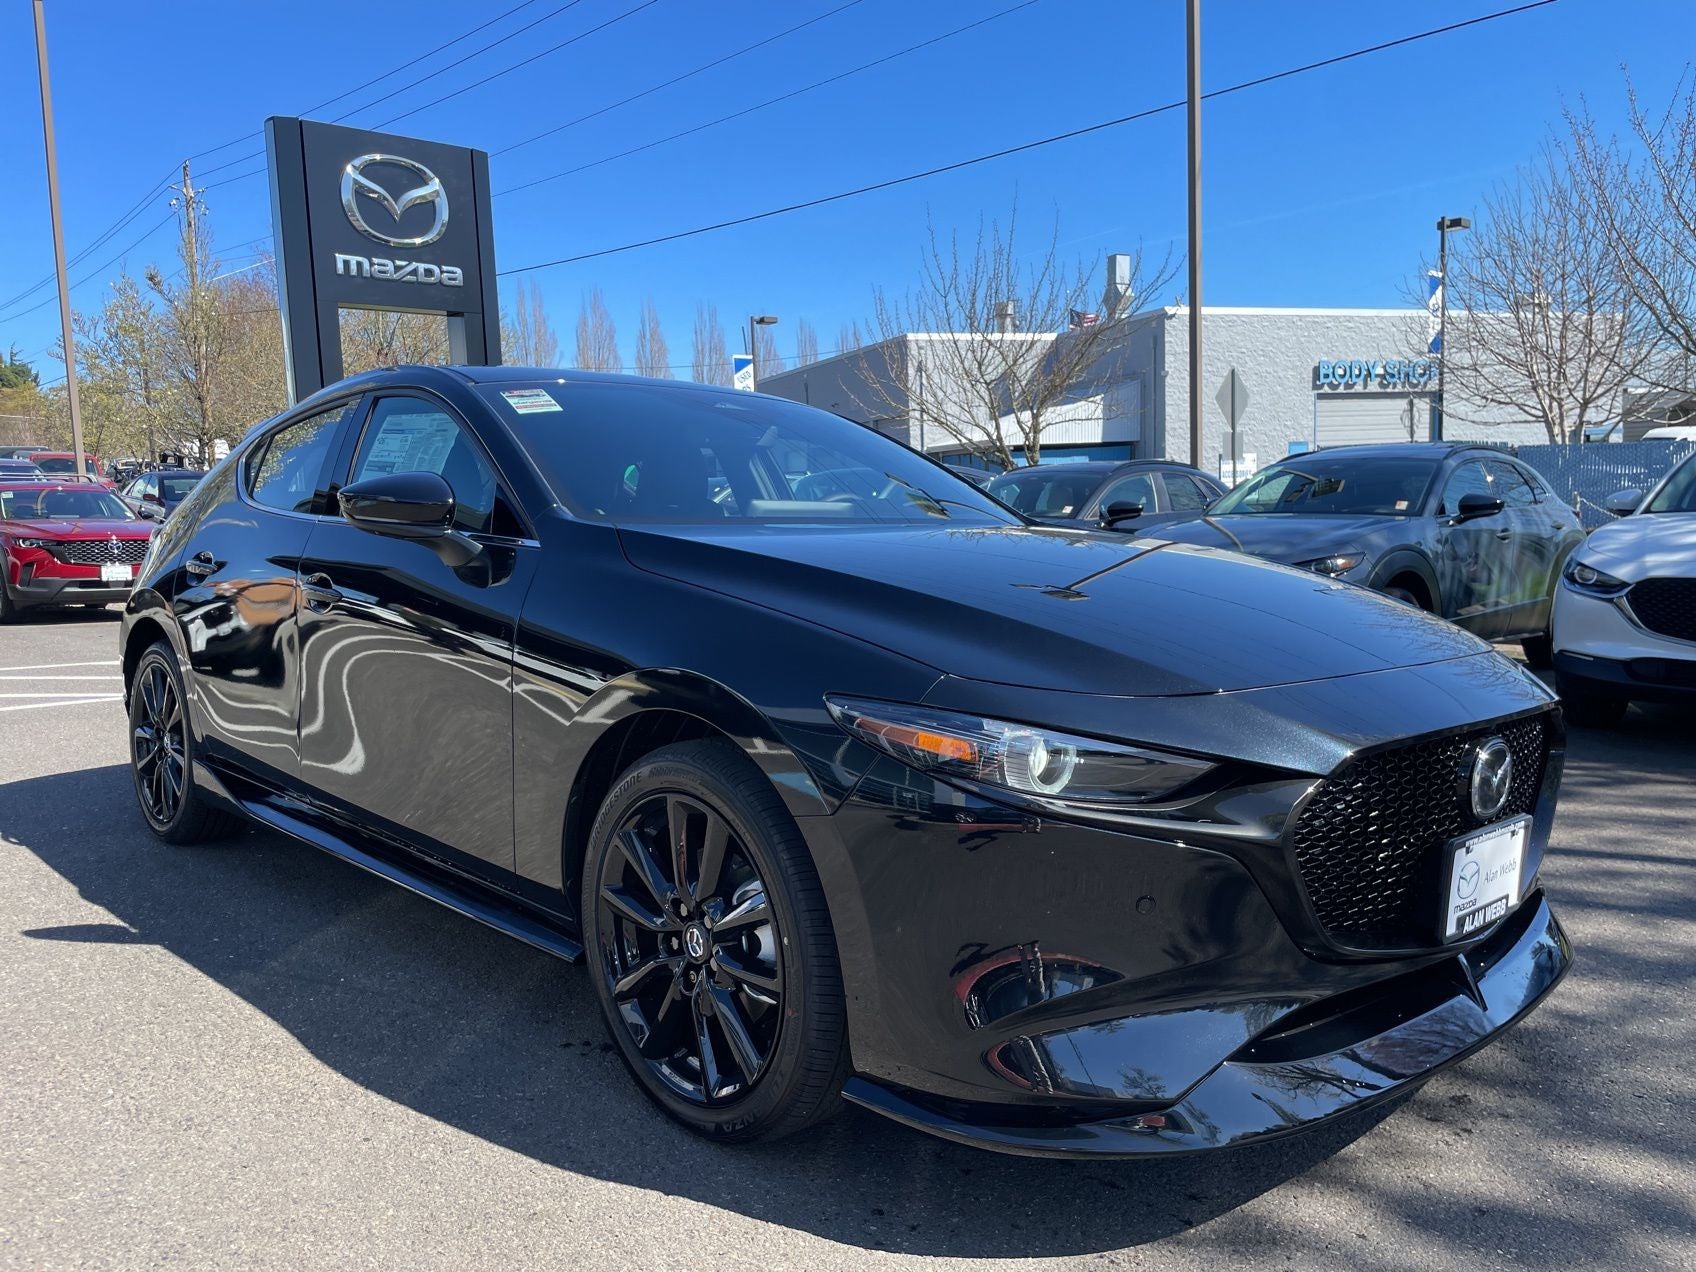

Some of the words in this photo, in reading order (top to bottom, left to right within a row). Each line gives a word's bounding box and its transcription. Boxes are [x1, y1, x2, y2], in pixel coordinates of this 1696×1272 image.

[1318, 359, 1380, 384] BODY
[1484, 869, 1499, 883] Alan
[1500, 859, 1517, 876] Webb
[1463, 908, 1485, 934] ALAN
[1485, 898, 1507, 922] WEBB
